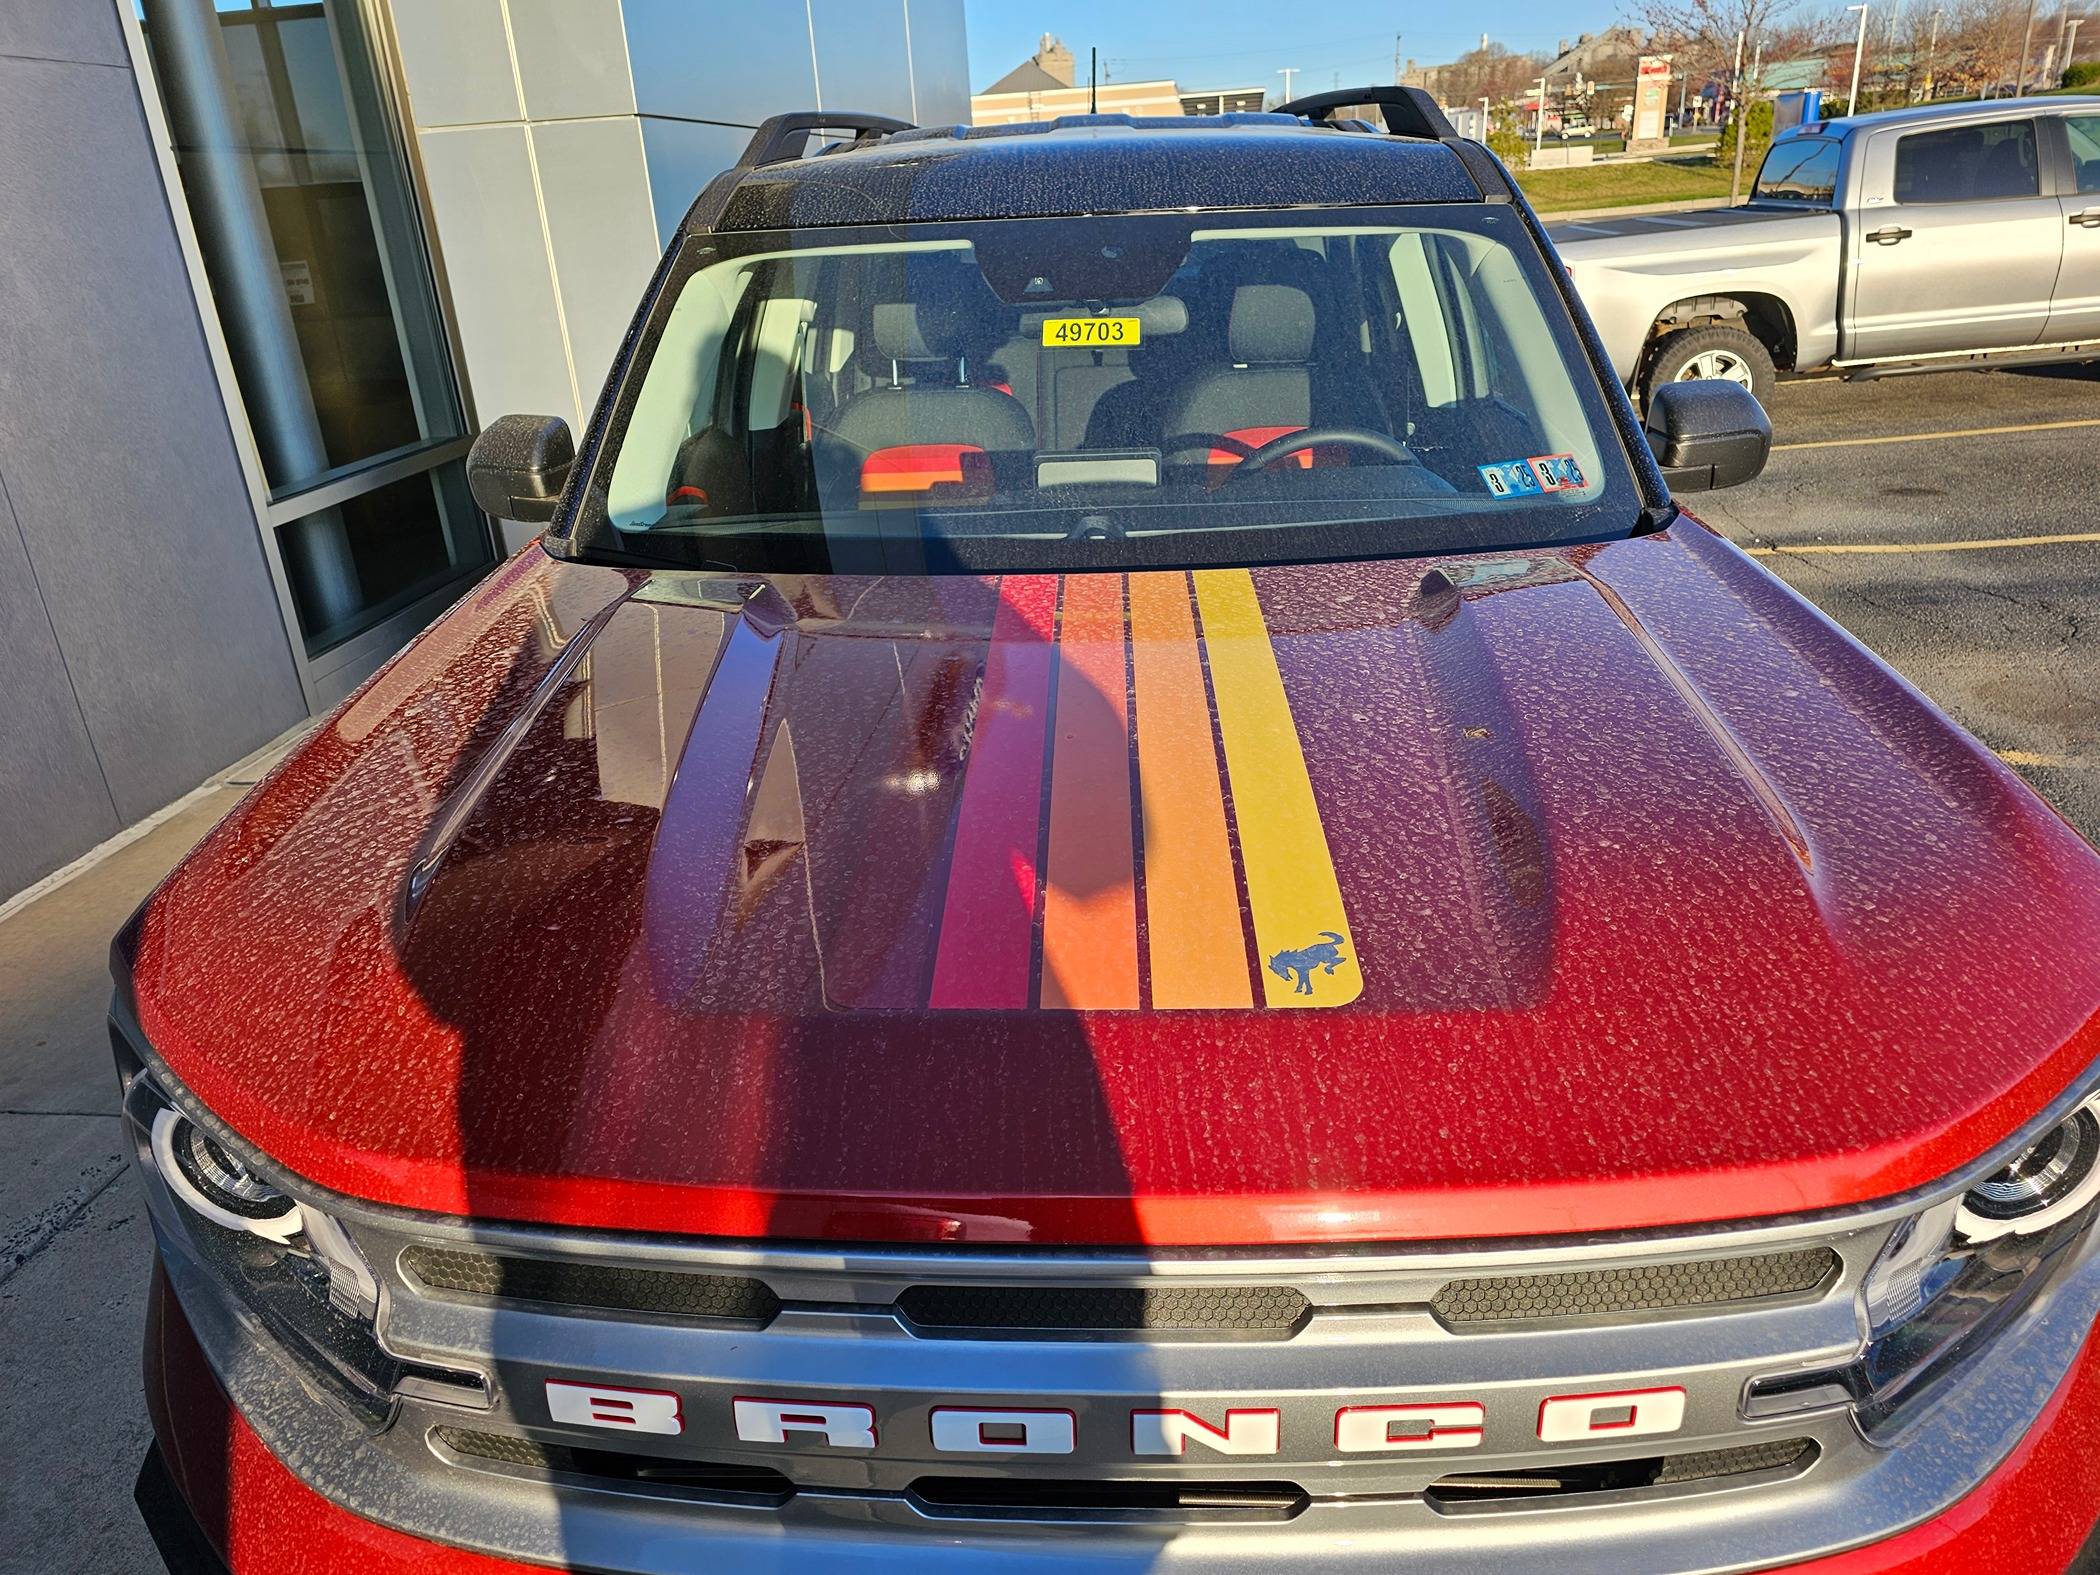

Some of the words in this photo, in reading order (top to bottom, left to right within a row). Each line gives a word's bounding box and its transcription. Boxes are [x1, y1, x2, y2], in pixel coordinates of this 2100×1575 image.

[1055, 322, 1124, 342] 49703
[1489, 473, 1505, 493] 3
[1515, 464, 1536, 488] 25
[1538, 462, 1557, 486] 3
[544, 1377, 1687, 1455] BRONCO
